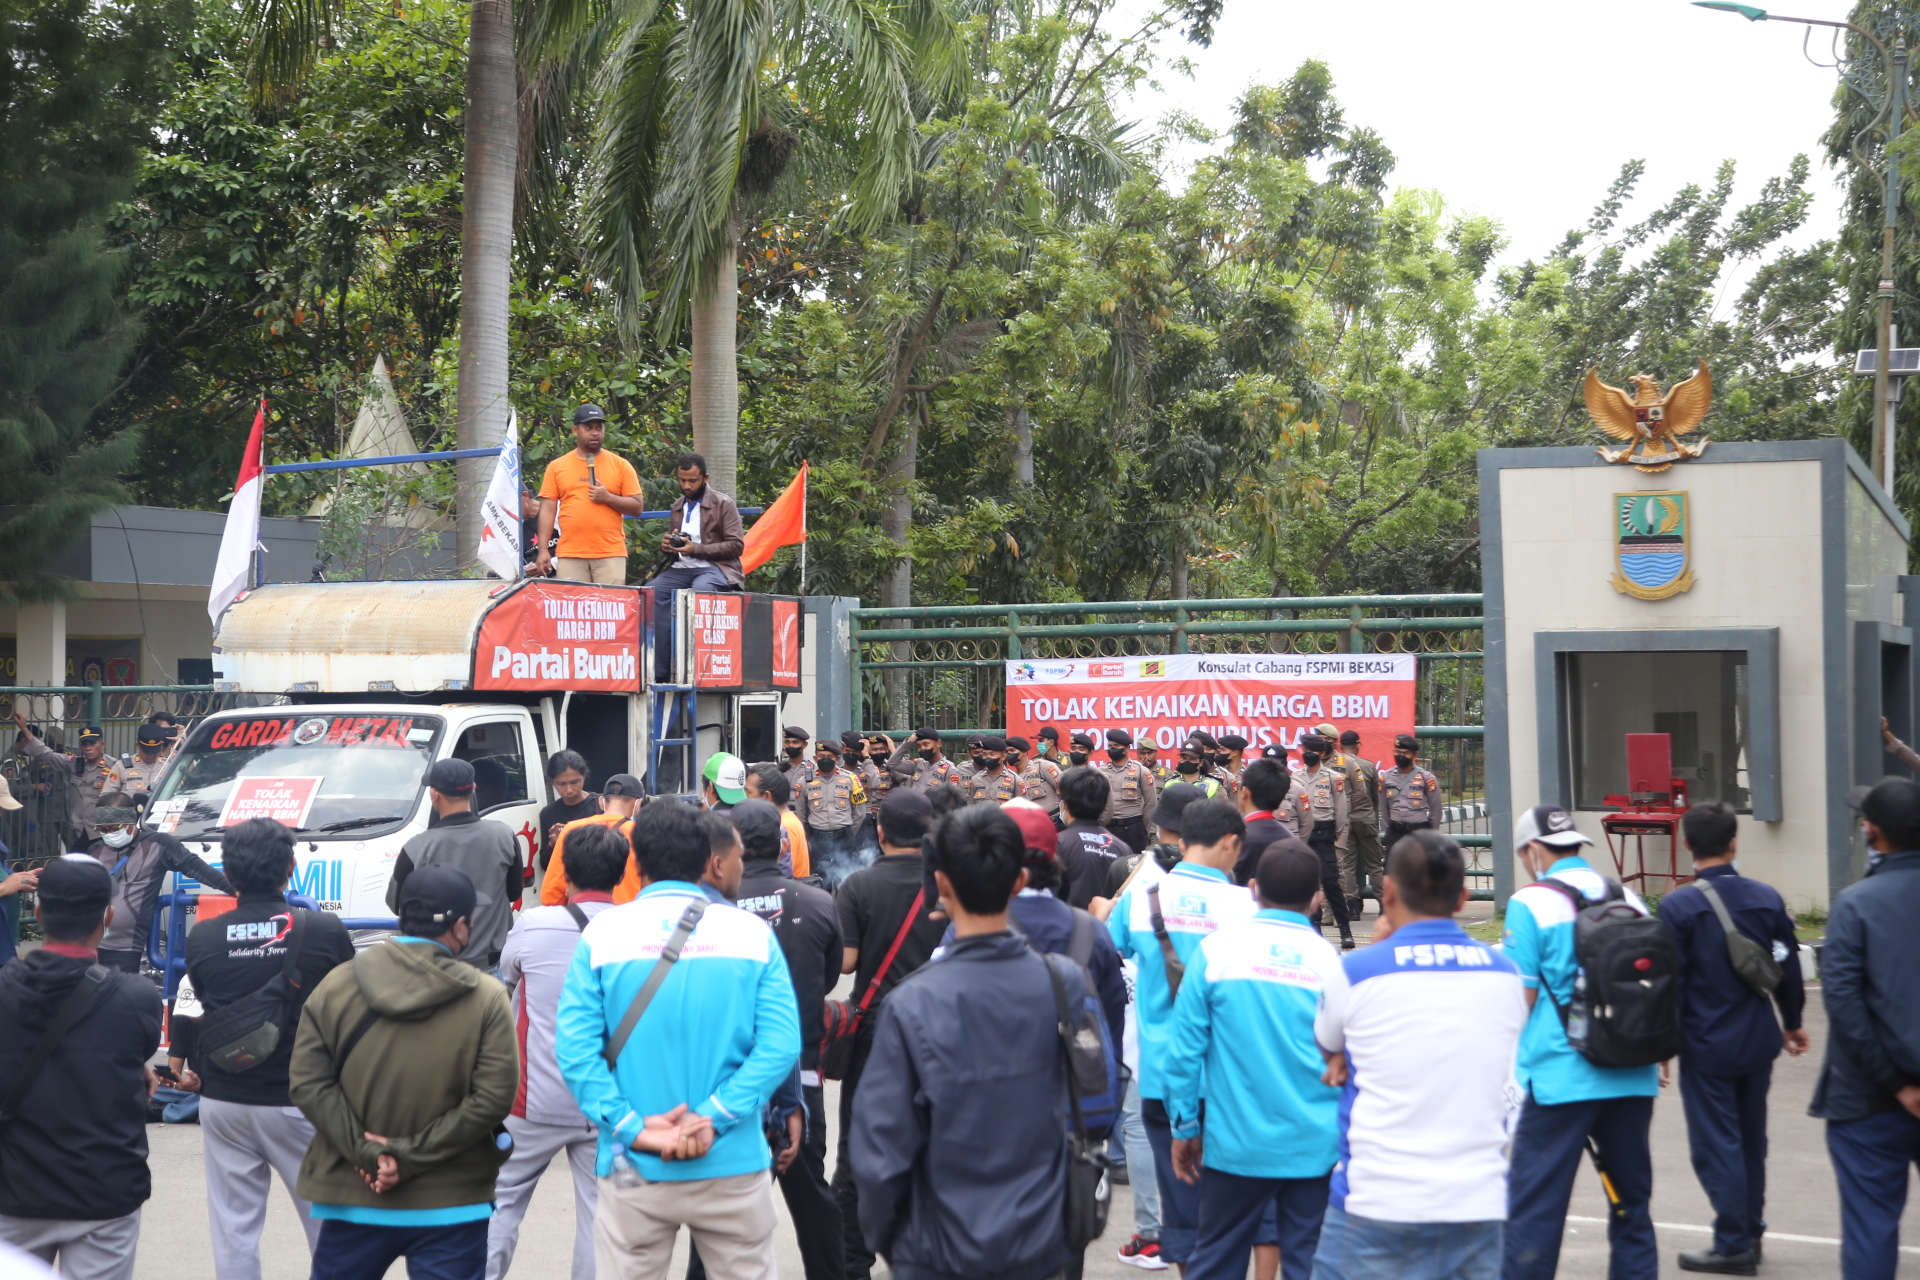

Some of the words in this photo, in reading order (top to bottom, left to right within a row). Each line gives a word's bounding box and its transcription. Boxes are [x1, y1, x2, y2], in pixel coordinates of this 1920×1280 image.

[485, 501, 500, 521] AMK
[543, 600, 575, 619] TOLAK
[577, 600, 626, 620] KENAIKAN
[699, 599, 711, 614] WE
[712, 600, 727, 614] ARE
[557, 620, 592, 640] HARGA
[593, 621, 616, 640] BBM
[694, 614, 704, 629] HE
[705, 615, 739, 630] WORKING
[703, 630, 725, 645] CLASS
[491, 645, 570, 679] Partai
[574, 647, 635, 680] Buruh
[712, 654, 731, 665] Partai
[712, 665, 731, 675] Buruh
[1198, 661, 1251, 674] Konsulat
[1255, 661, 1302, 676] Cabang
[1305, 662, 1345, 674] FSPMI
[1349, 662, 1394, 674] BEKASI
[1021, 697, 1098, 721] TOLAK
[1104, 694, 1230, 719] KENAIKAN
[1237, 694, 1325, 718] HARGA
[1331, 695, 1389, 719] BBM
[210, 719, 297, 749] GARDA
[322, 717, 413, 747] METAL
[254, 788, 294, 799] TOLAK
[237, 799, 301, 809] KENAIKAN
[228, 809, 269, 820] HARGA
[271, 809, 300, 820] BBM
[736, 894, 783, 910] FSPMI
[227, 921, 278, 938] FSPMI
[228, 946, 266, 958] Solidarity
[266, 946, 288, 957] Fore
[1394, 943, 1493, 967] FSPMI
